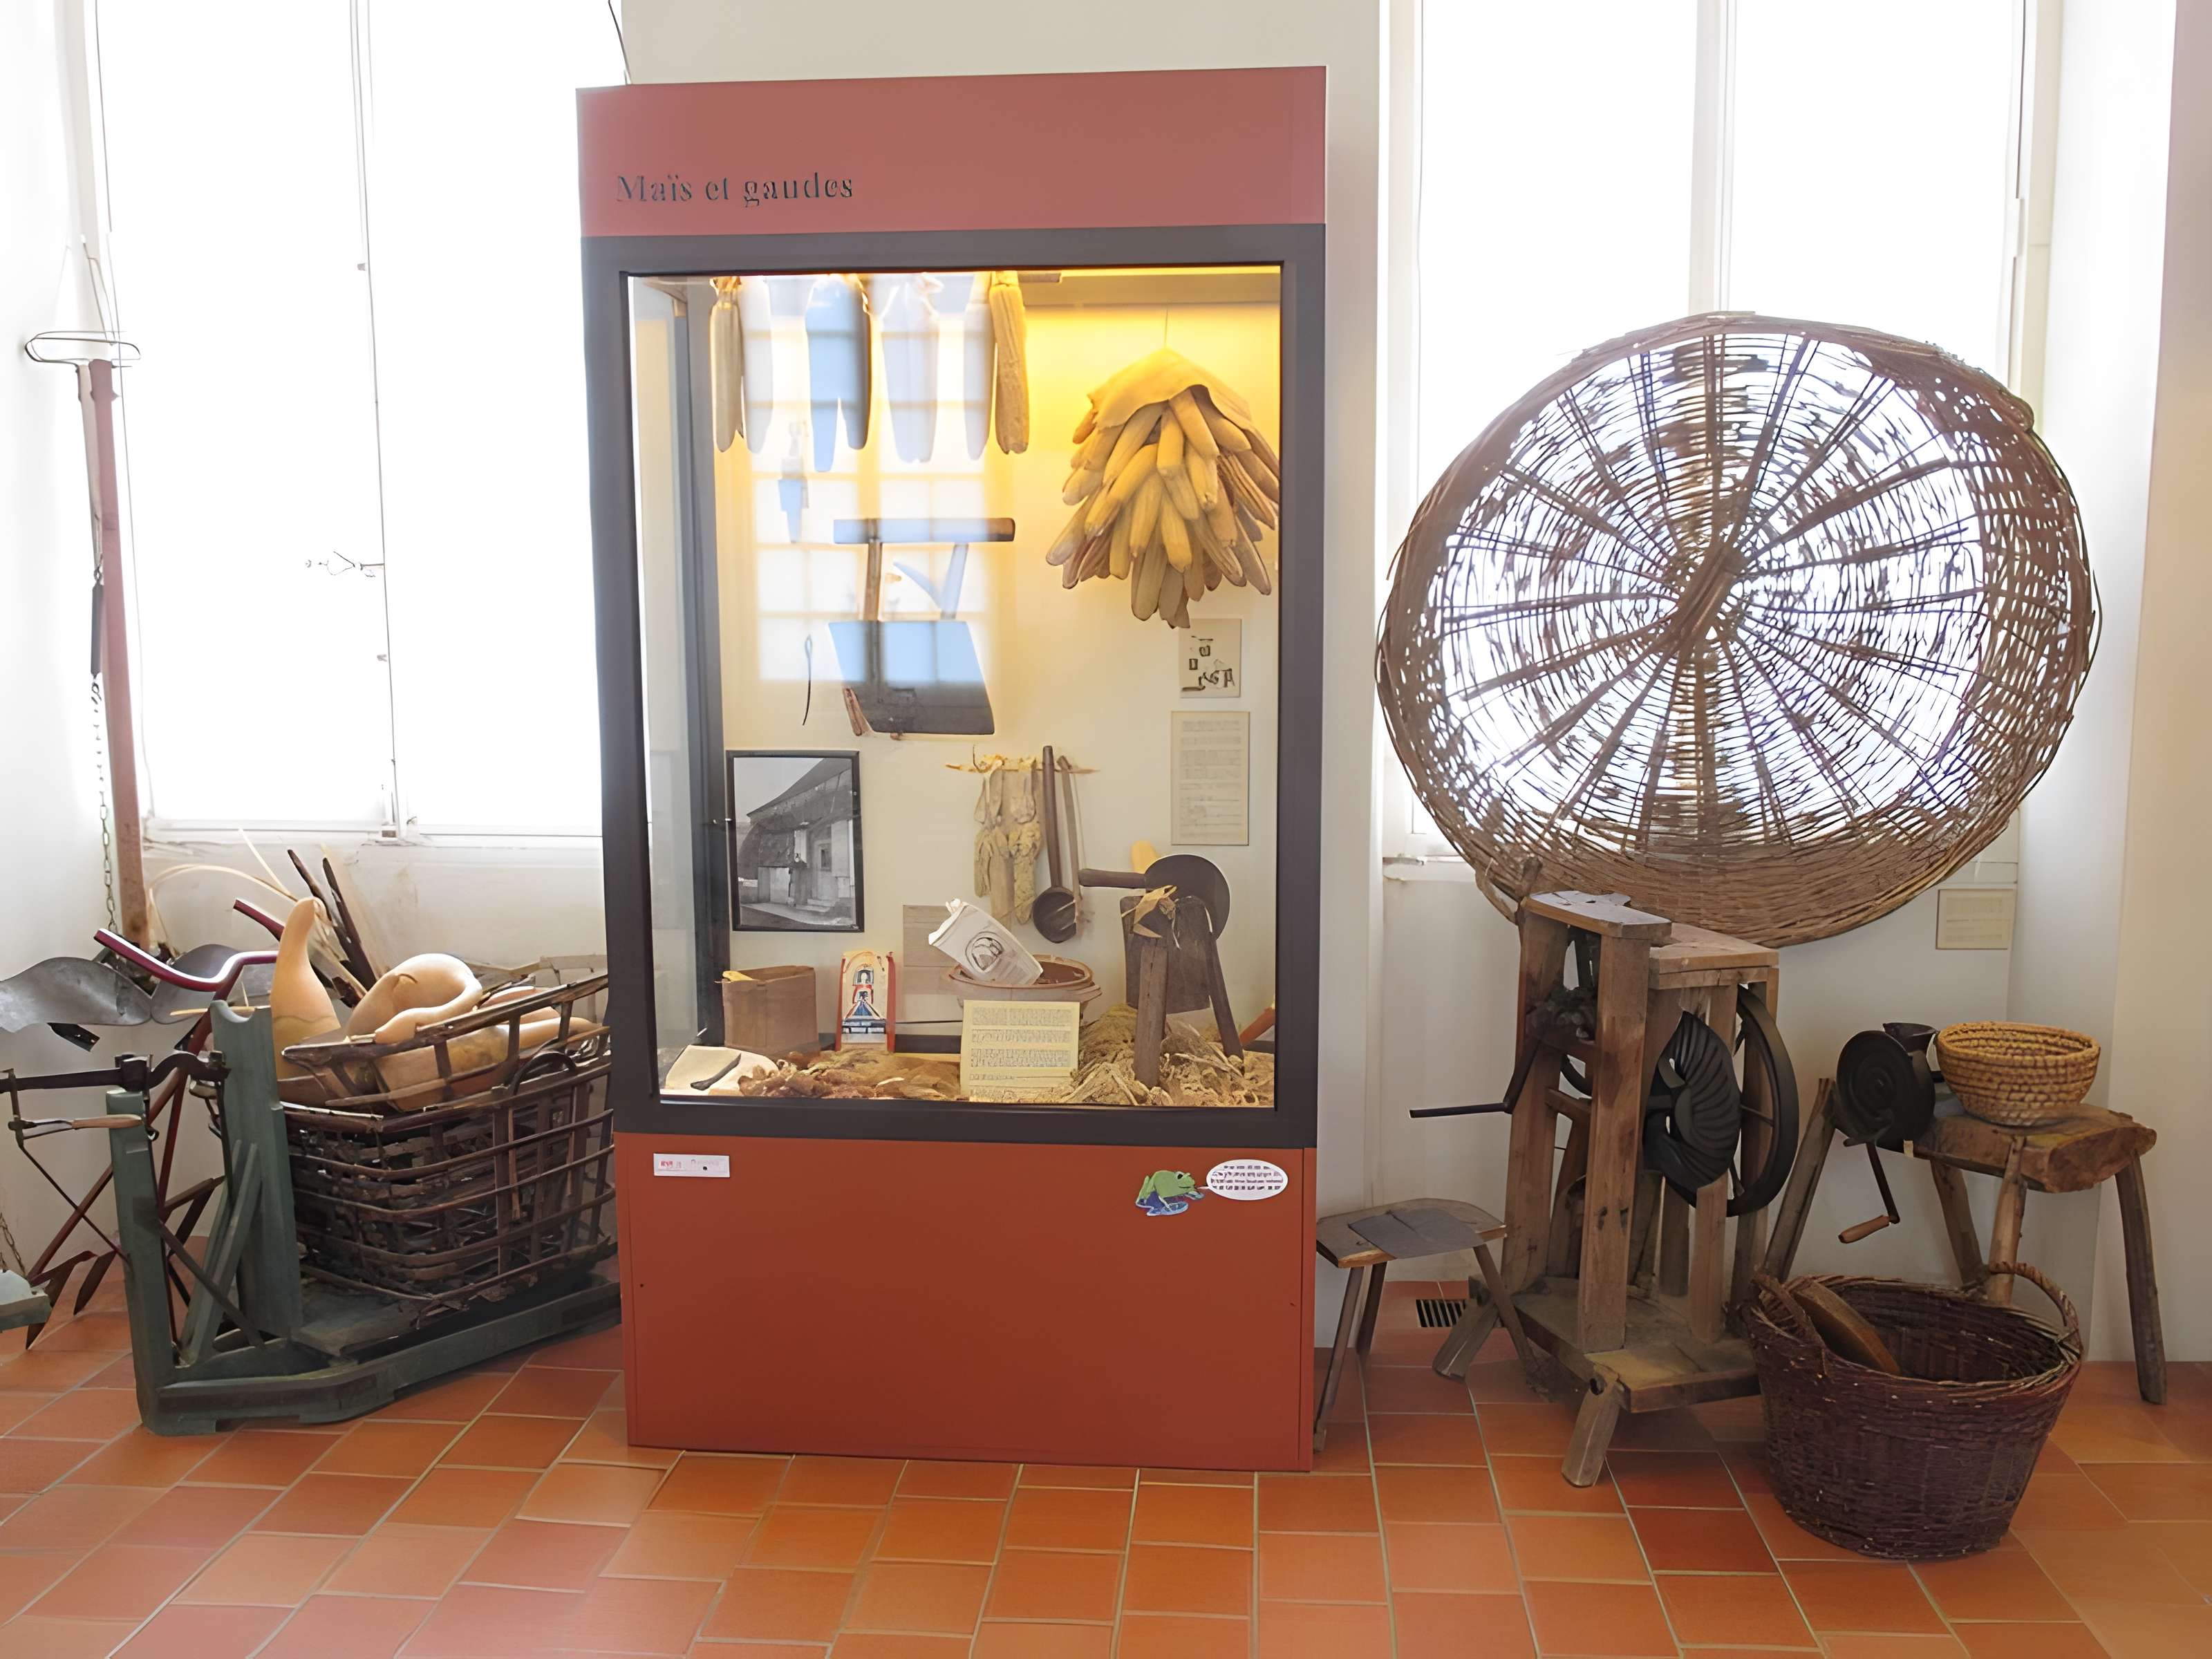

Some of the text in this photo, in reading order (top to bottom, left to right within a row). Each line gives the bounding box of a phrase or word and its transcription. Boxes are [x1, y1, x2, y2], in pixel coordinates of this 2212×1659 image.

[617, 171, 852, 207] Maïs et gaudes
